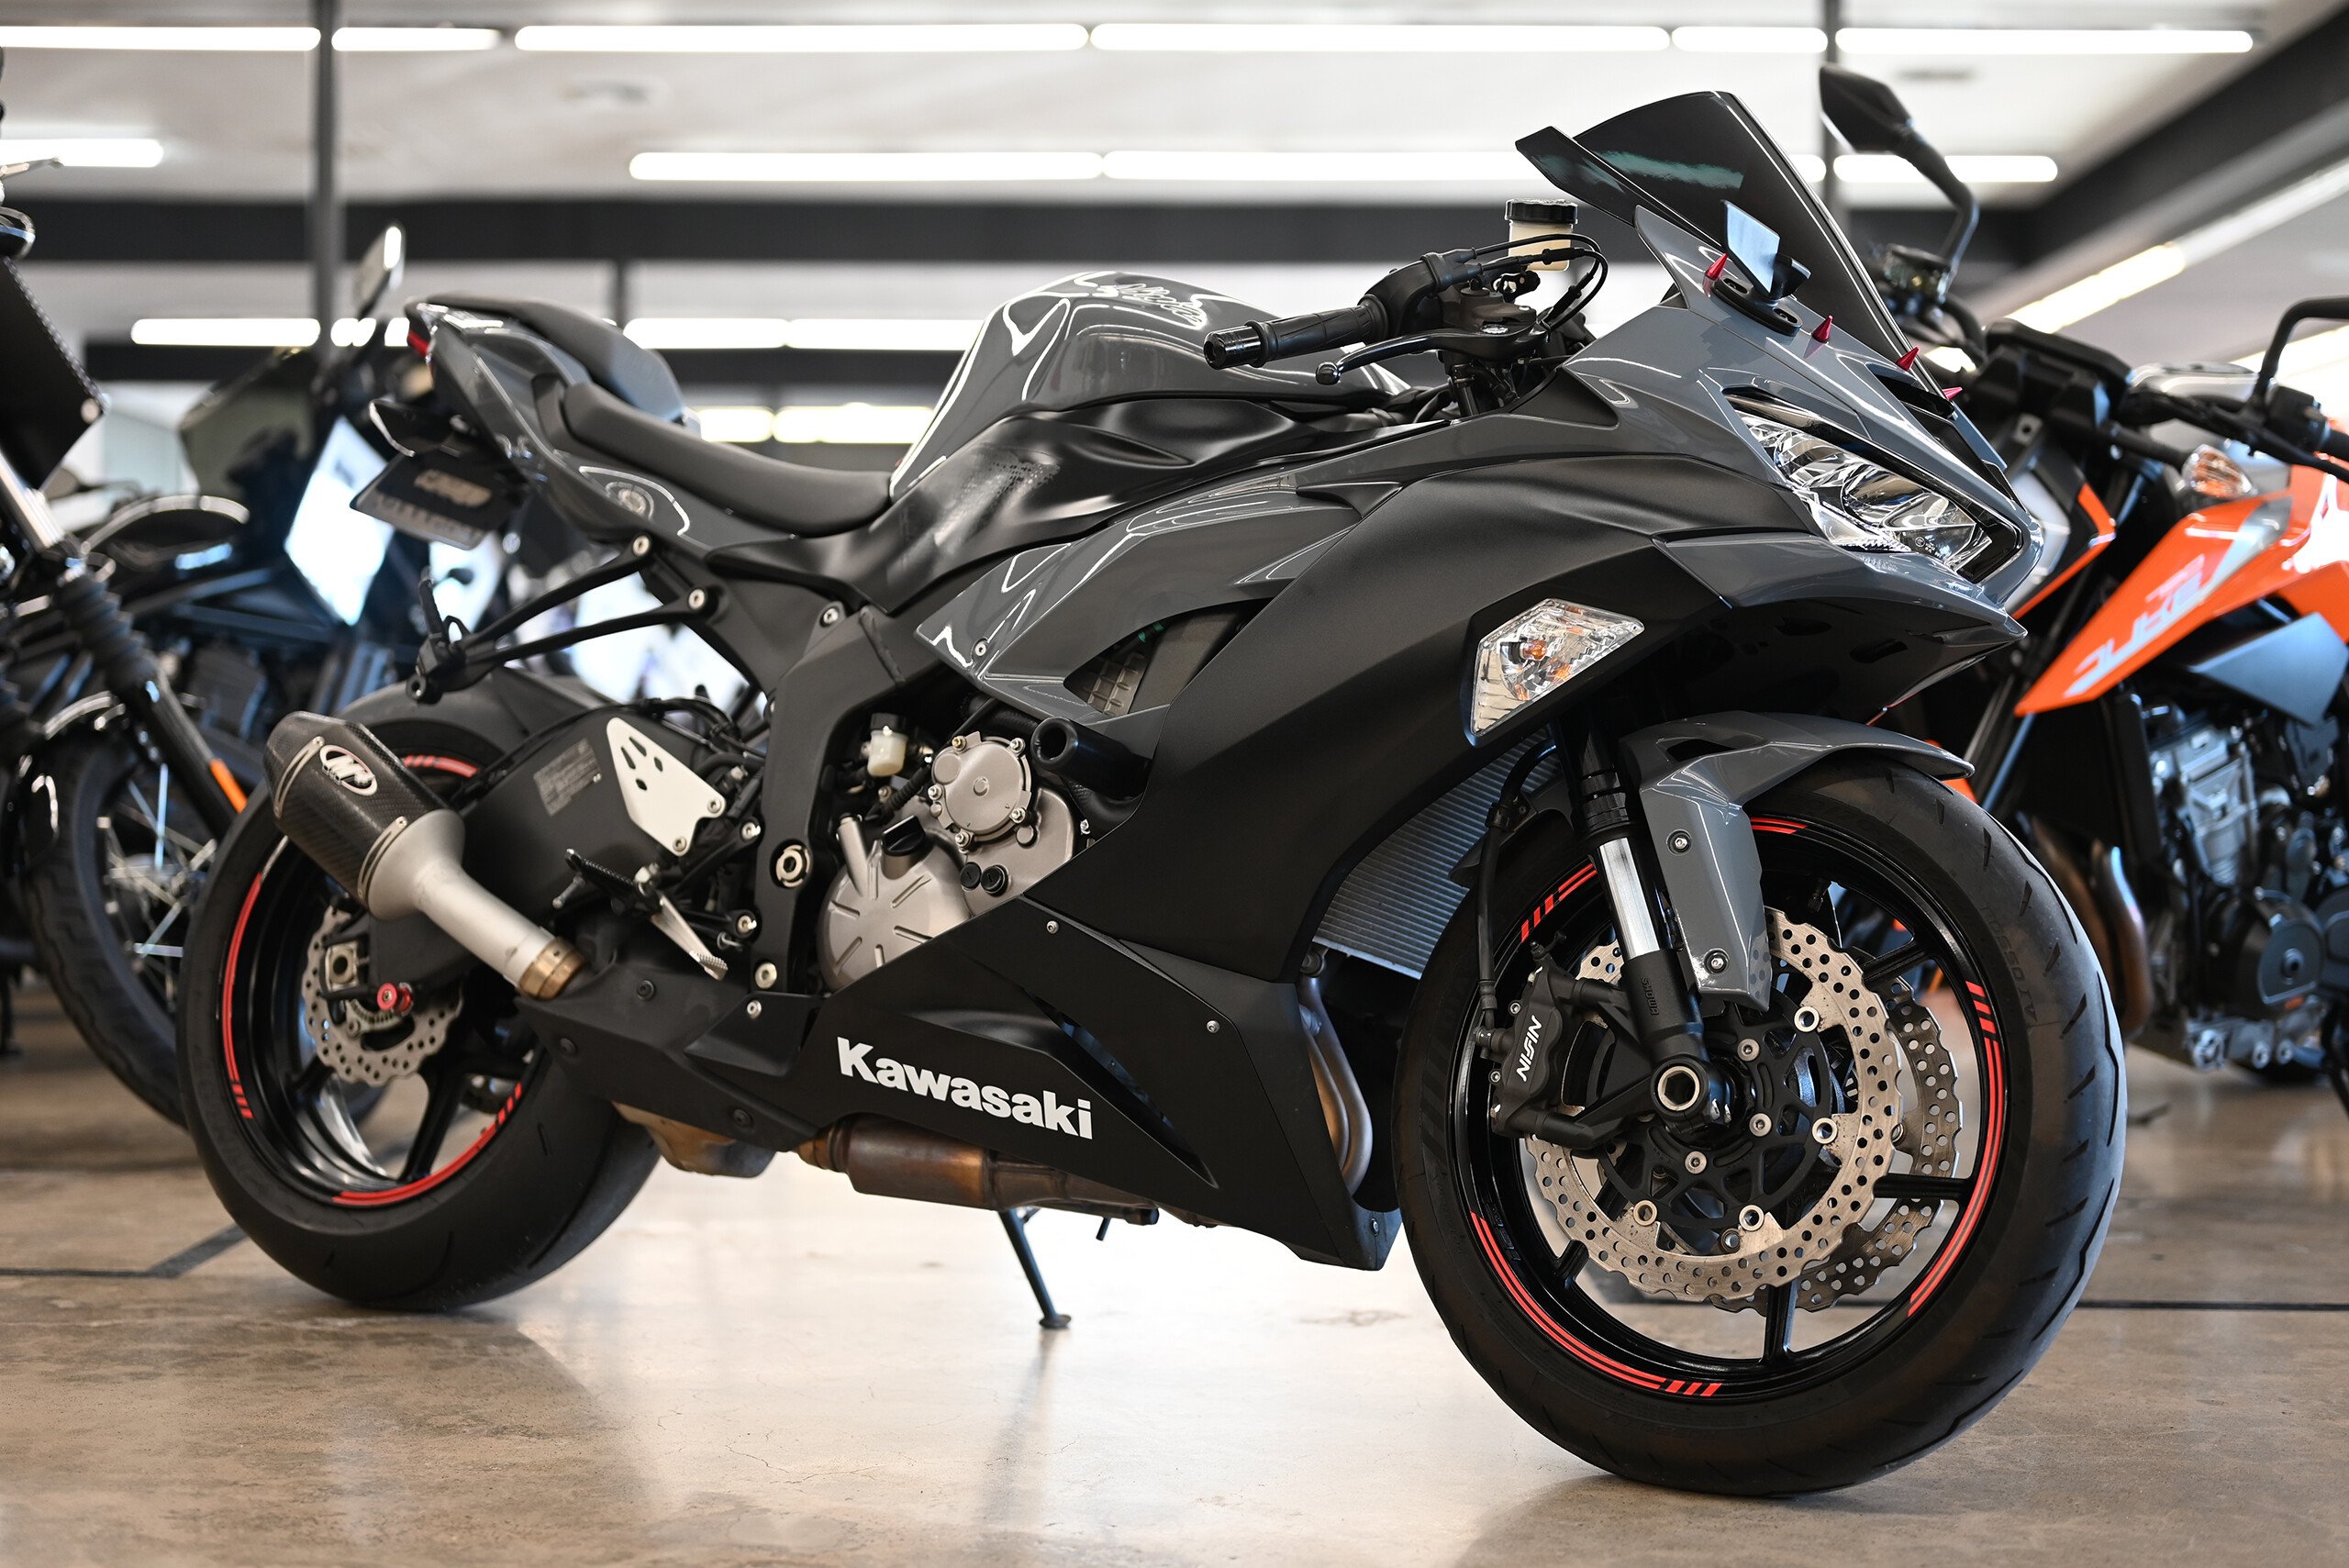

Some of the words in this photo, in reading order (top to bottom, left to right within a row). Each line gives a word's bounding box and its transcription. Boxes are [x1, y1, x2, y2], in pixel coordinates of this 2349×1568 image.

[1642, 977, 1659, 1016] SHOWA
[1516, 1014, 1542, 1083] NISSIN
[837, 1036, 1093, 1140] Kawasaki
